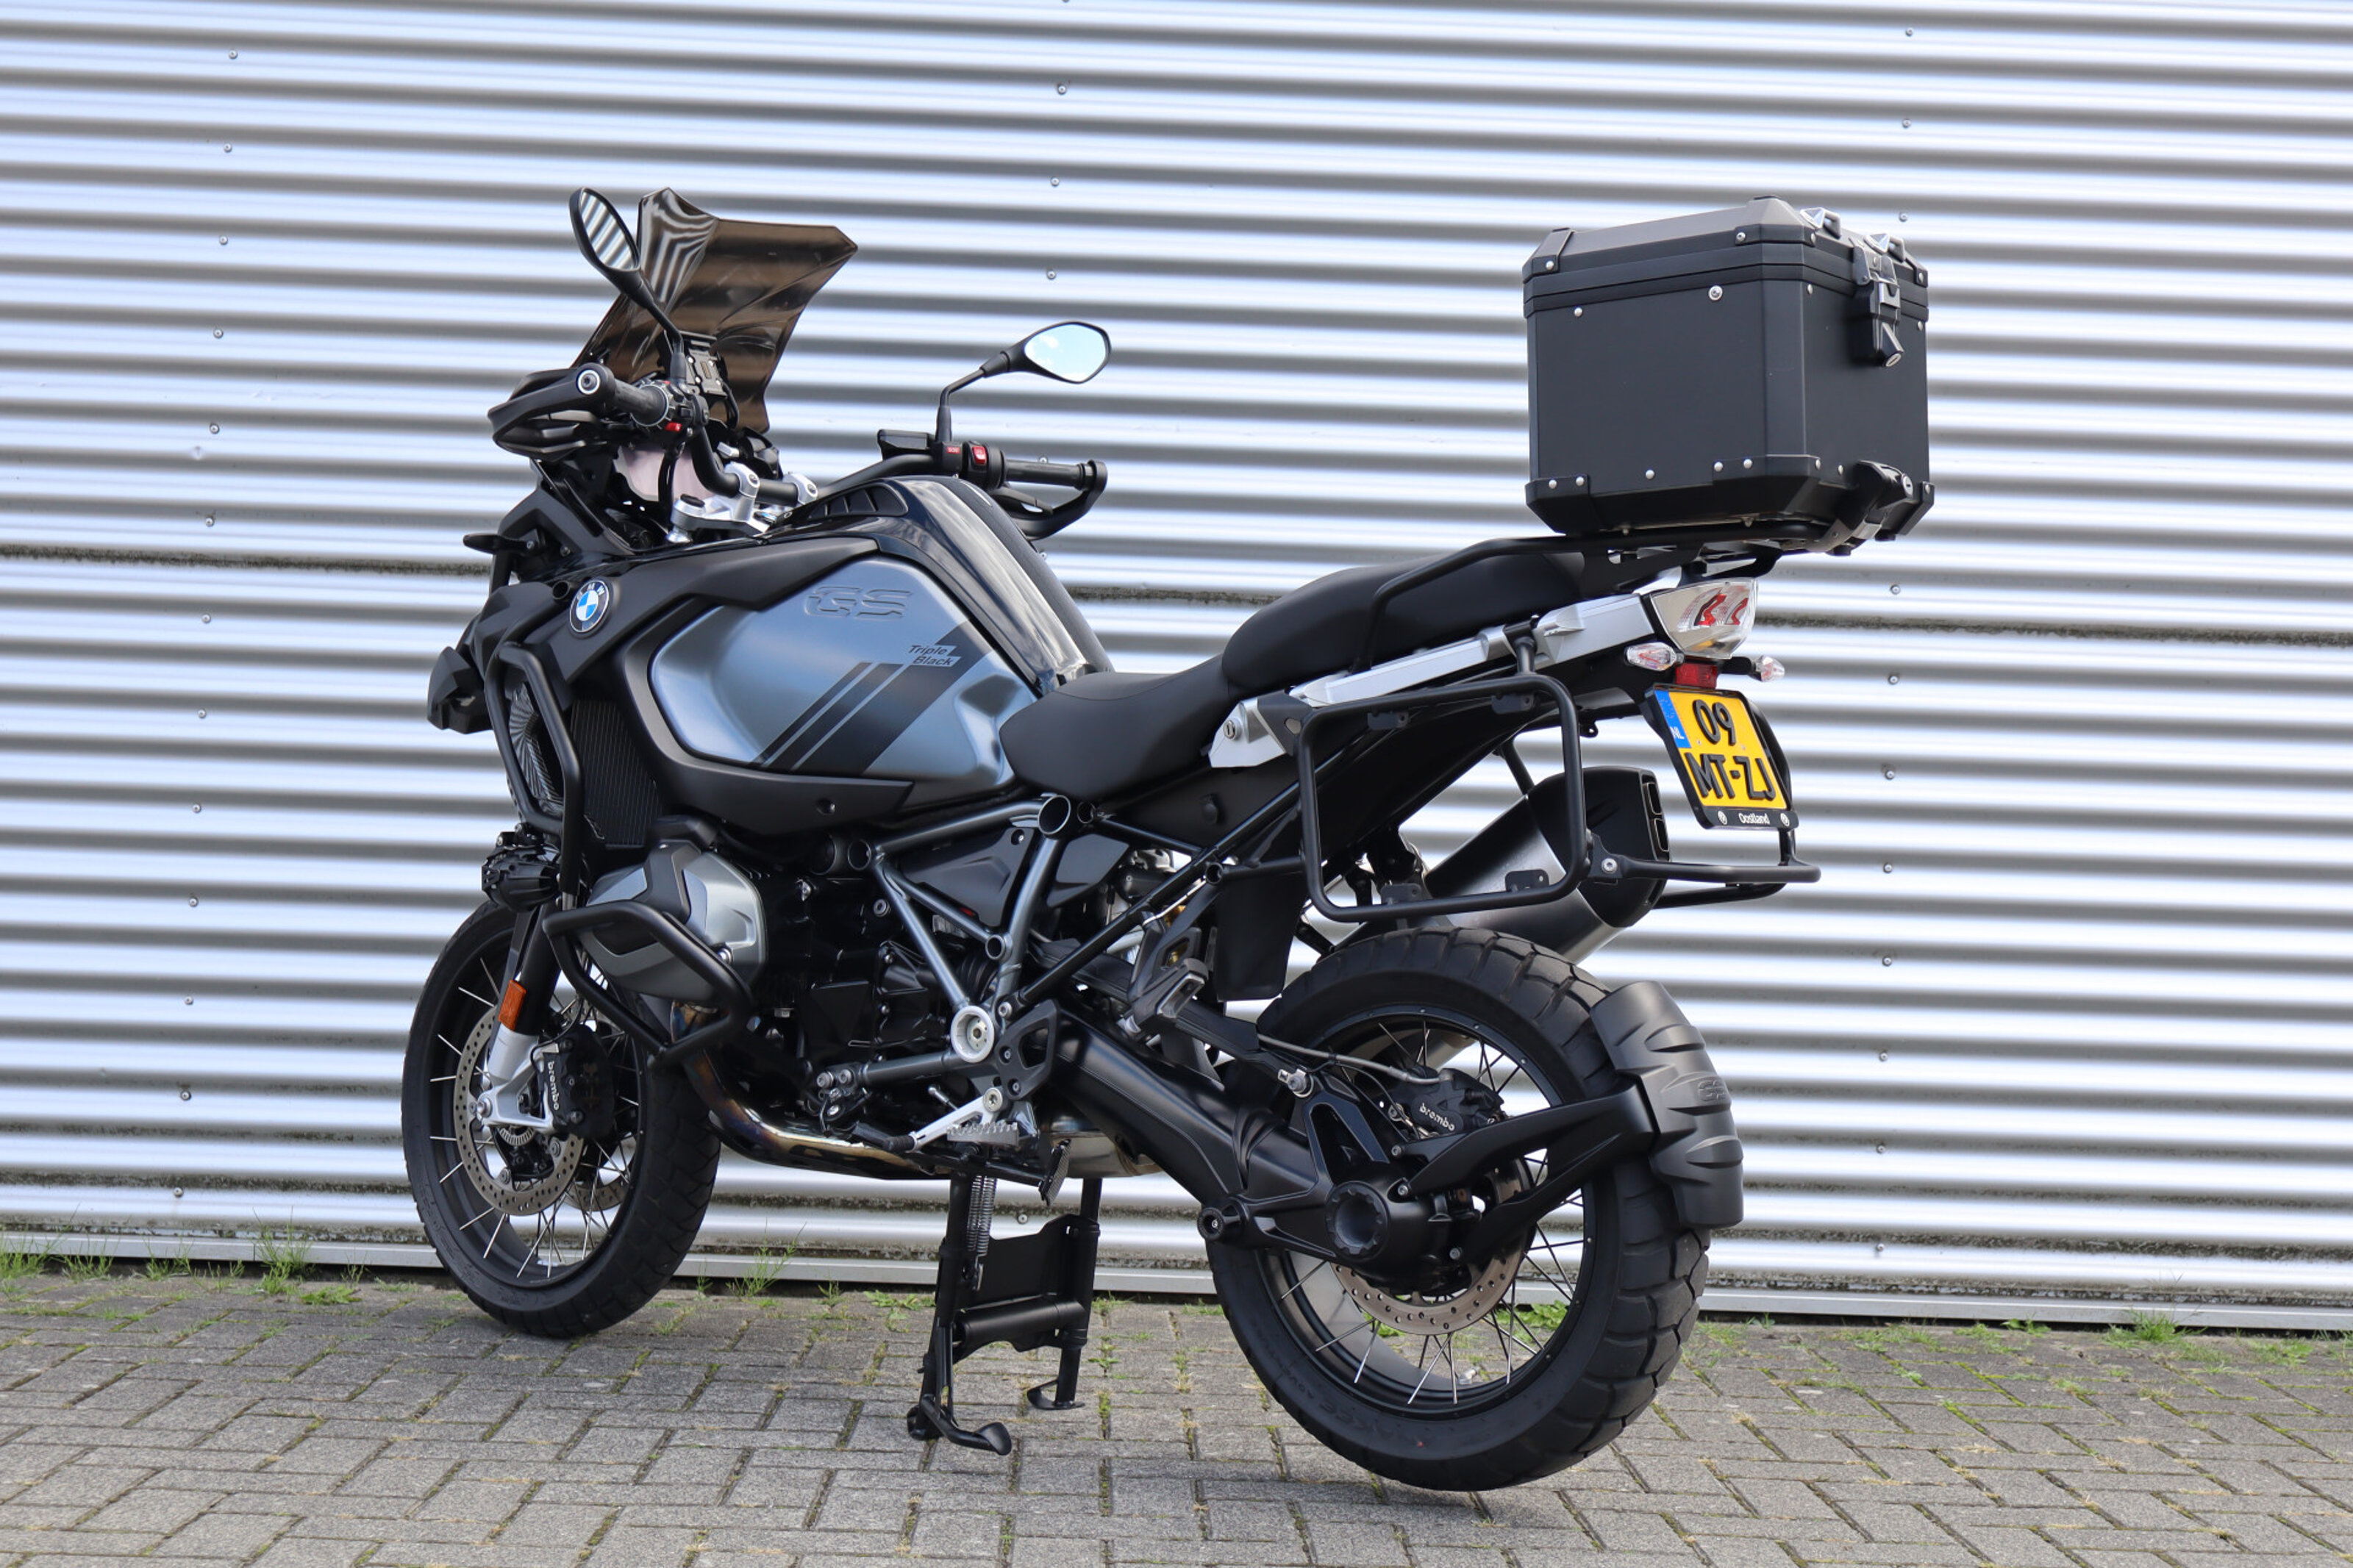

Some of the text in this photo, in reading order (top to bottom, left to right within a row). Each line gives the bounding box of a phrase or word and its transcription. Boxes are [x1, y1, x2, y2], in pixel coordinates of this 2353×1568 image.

[804, 586, 913, 622] GS
[908, 644, 948, 656] Triple
[913, 656, 954, 666] Black
[1669, 726, 1685, 740] NL
[1692, 699, 1736, 746] 09
[1684, 751, 1776, 802] MT-ZJ
[547, 1061, 560, 1111] brembo
[1418, 1102, 1456, 1132] brembo
